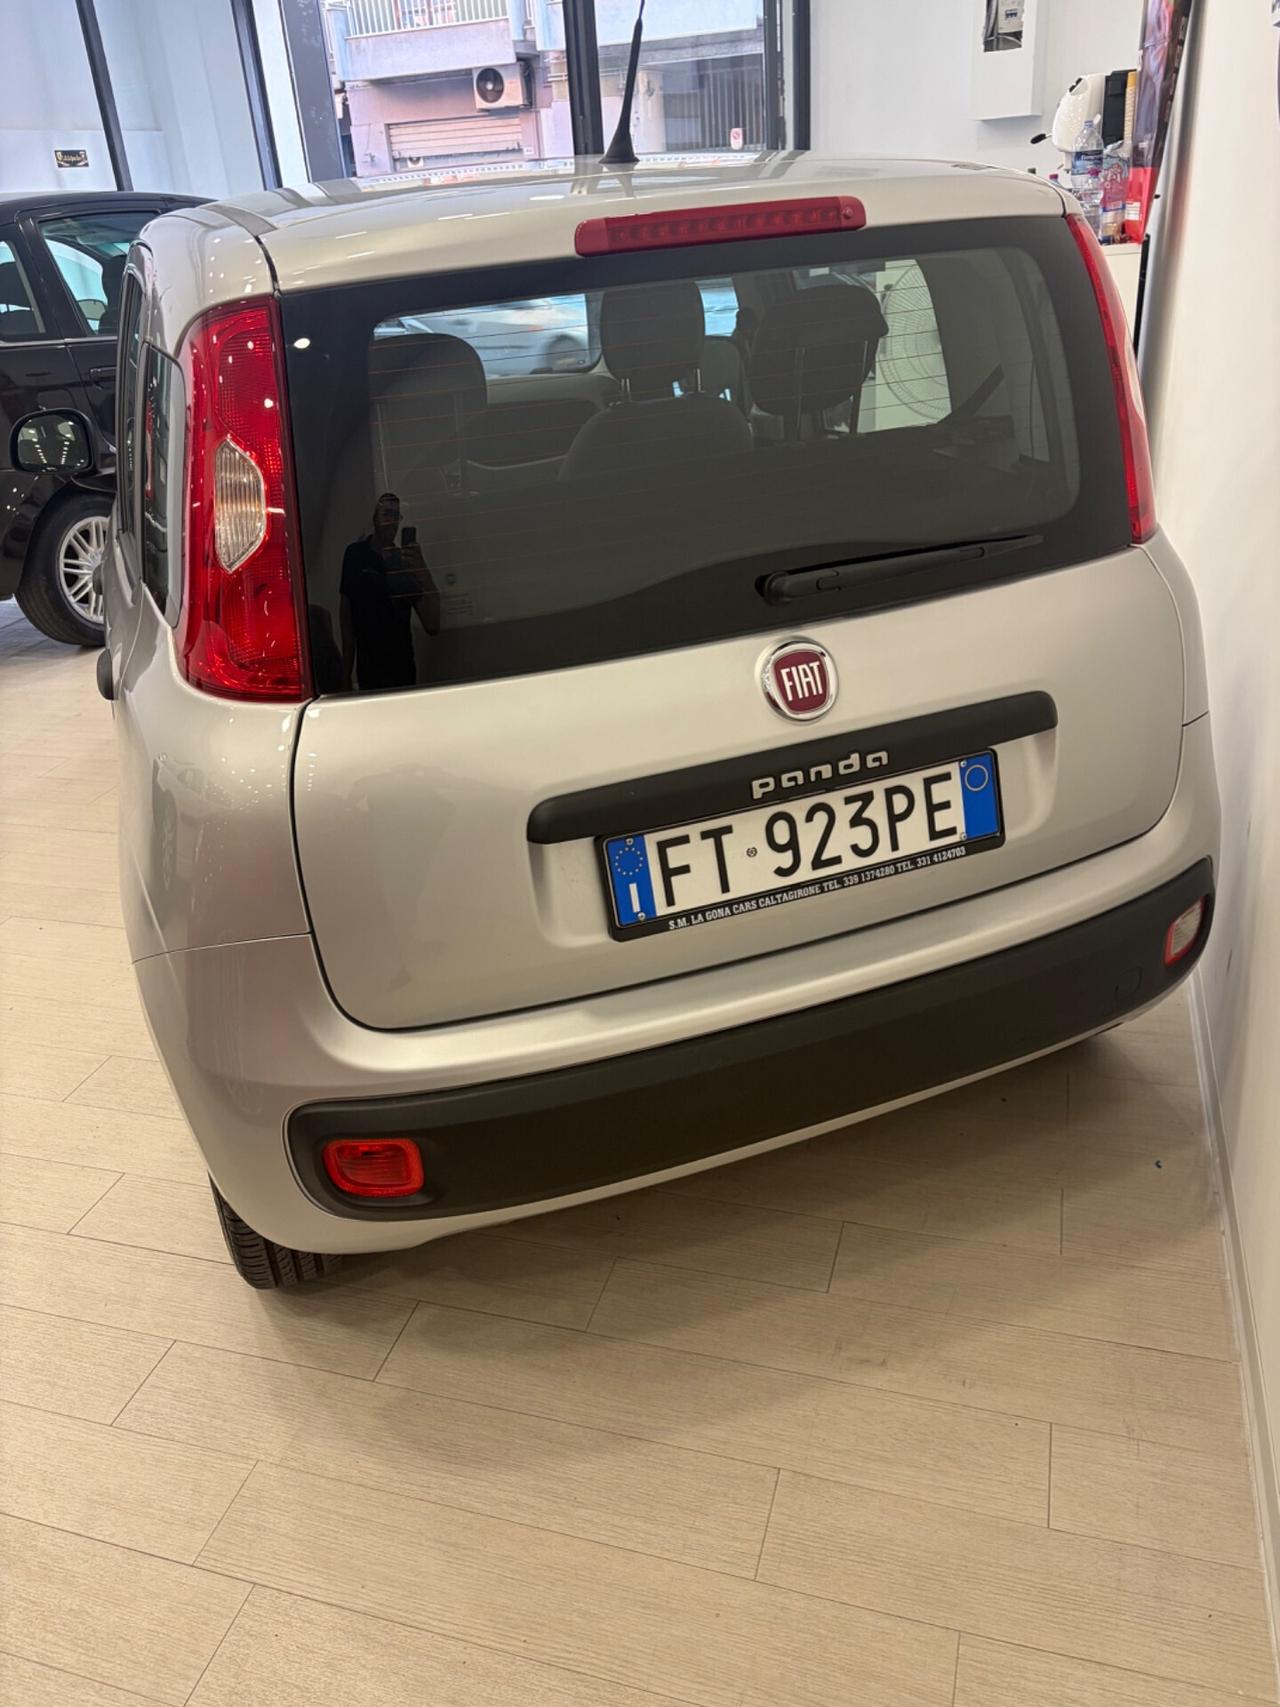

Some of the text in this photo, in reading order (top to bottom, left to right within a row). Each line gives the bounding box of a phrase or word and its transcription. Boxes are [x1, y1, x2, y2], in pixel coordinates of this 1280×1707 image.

[781, 661, 822, 701] FIAT
[752, 751, 888, 799] panda
[656, 772, 958, 907] FT 923PE
[668, 918, 689, 930] S.M.
[691, 913, 704, 924] LA
[706, 906, 731, 921] GONA
[733, 900, 757, 914] CARS
[759, 884, 821, 907] CALTAGIRONE
[823, 879, 841, 891] TEL.
[843, 874, 859, 886] 339
[896, 861, 914, 872] TEL.
[916, 856, 931, 867] 331
